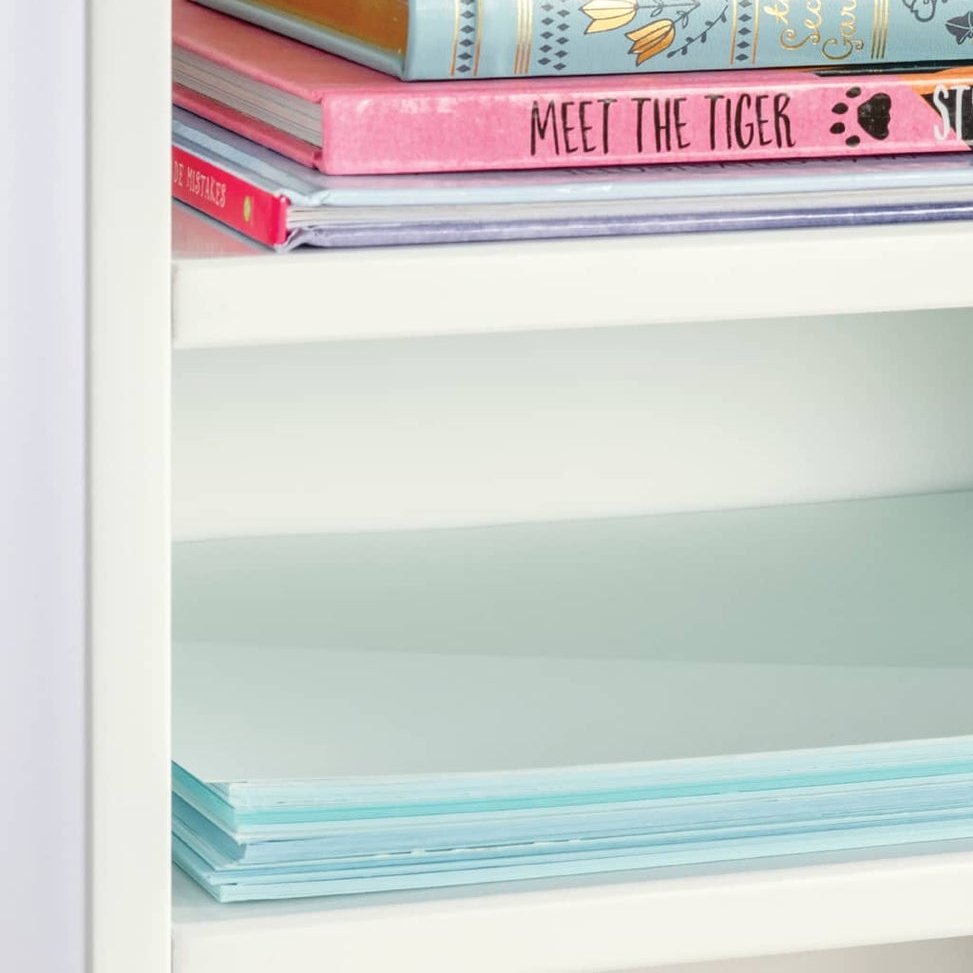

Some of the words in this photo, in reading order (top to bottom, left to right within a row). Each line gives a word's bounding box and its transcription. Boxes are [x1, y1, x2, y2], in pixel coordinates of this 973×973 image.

[530, 98, 617, 156] MEET
[631, 97, 691, 153] THE
[704, 93, 796, 150] TIGER
[187, 166, 227, 208] MISTAKES
